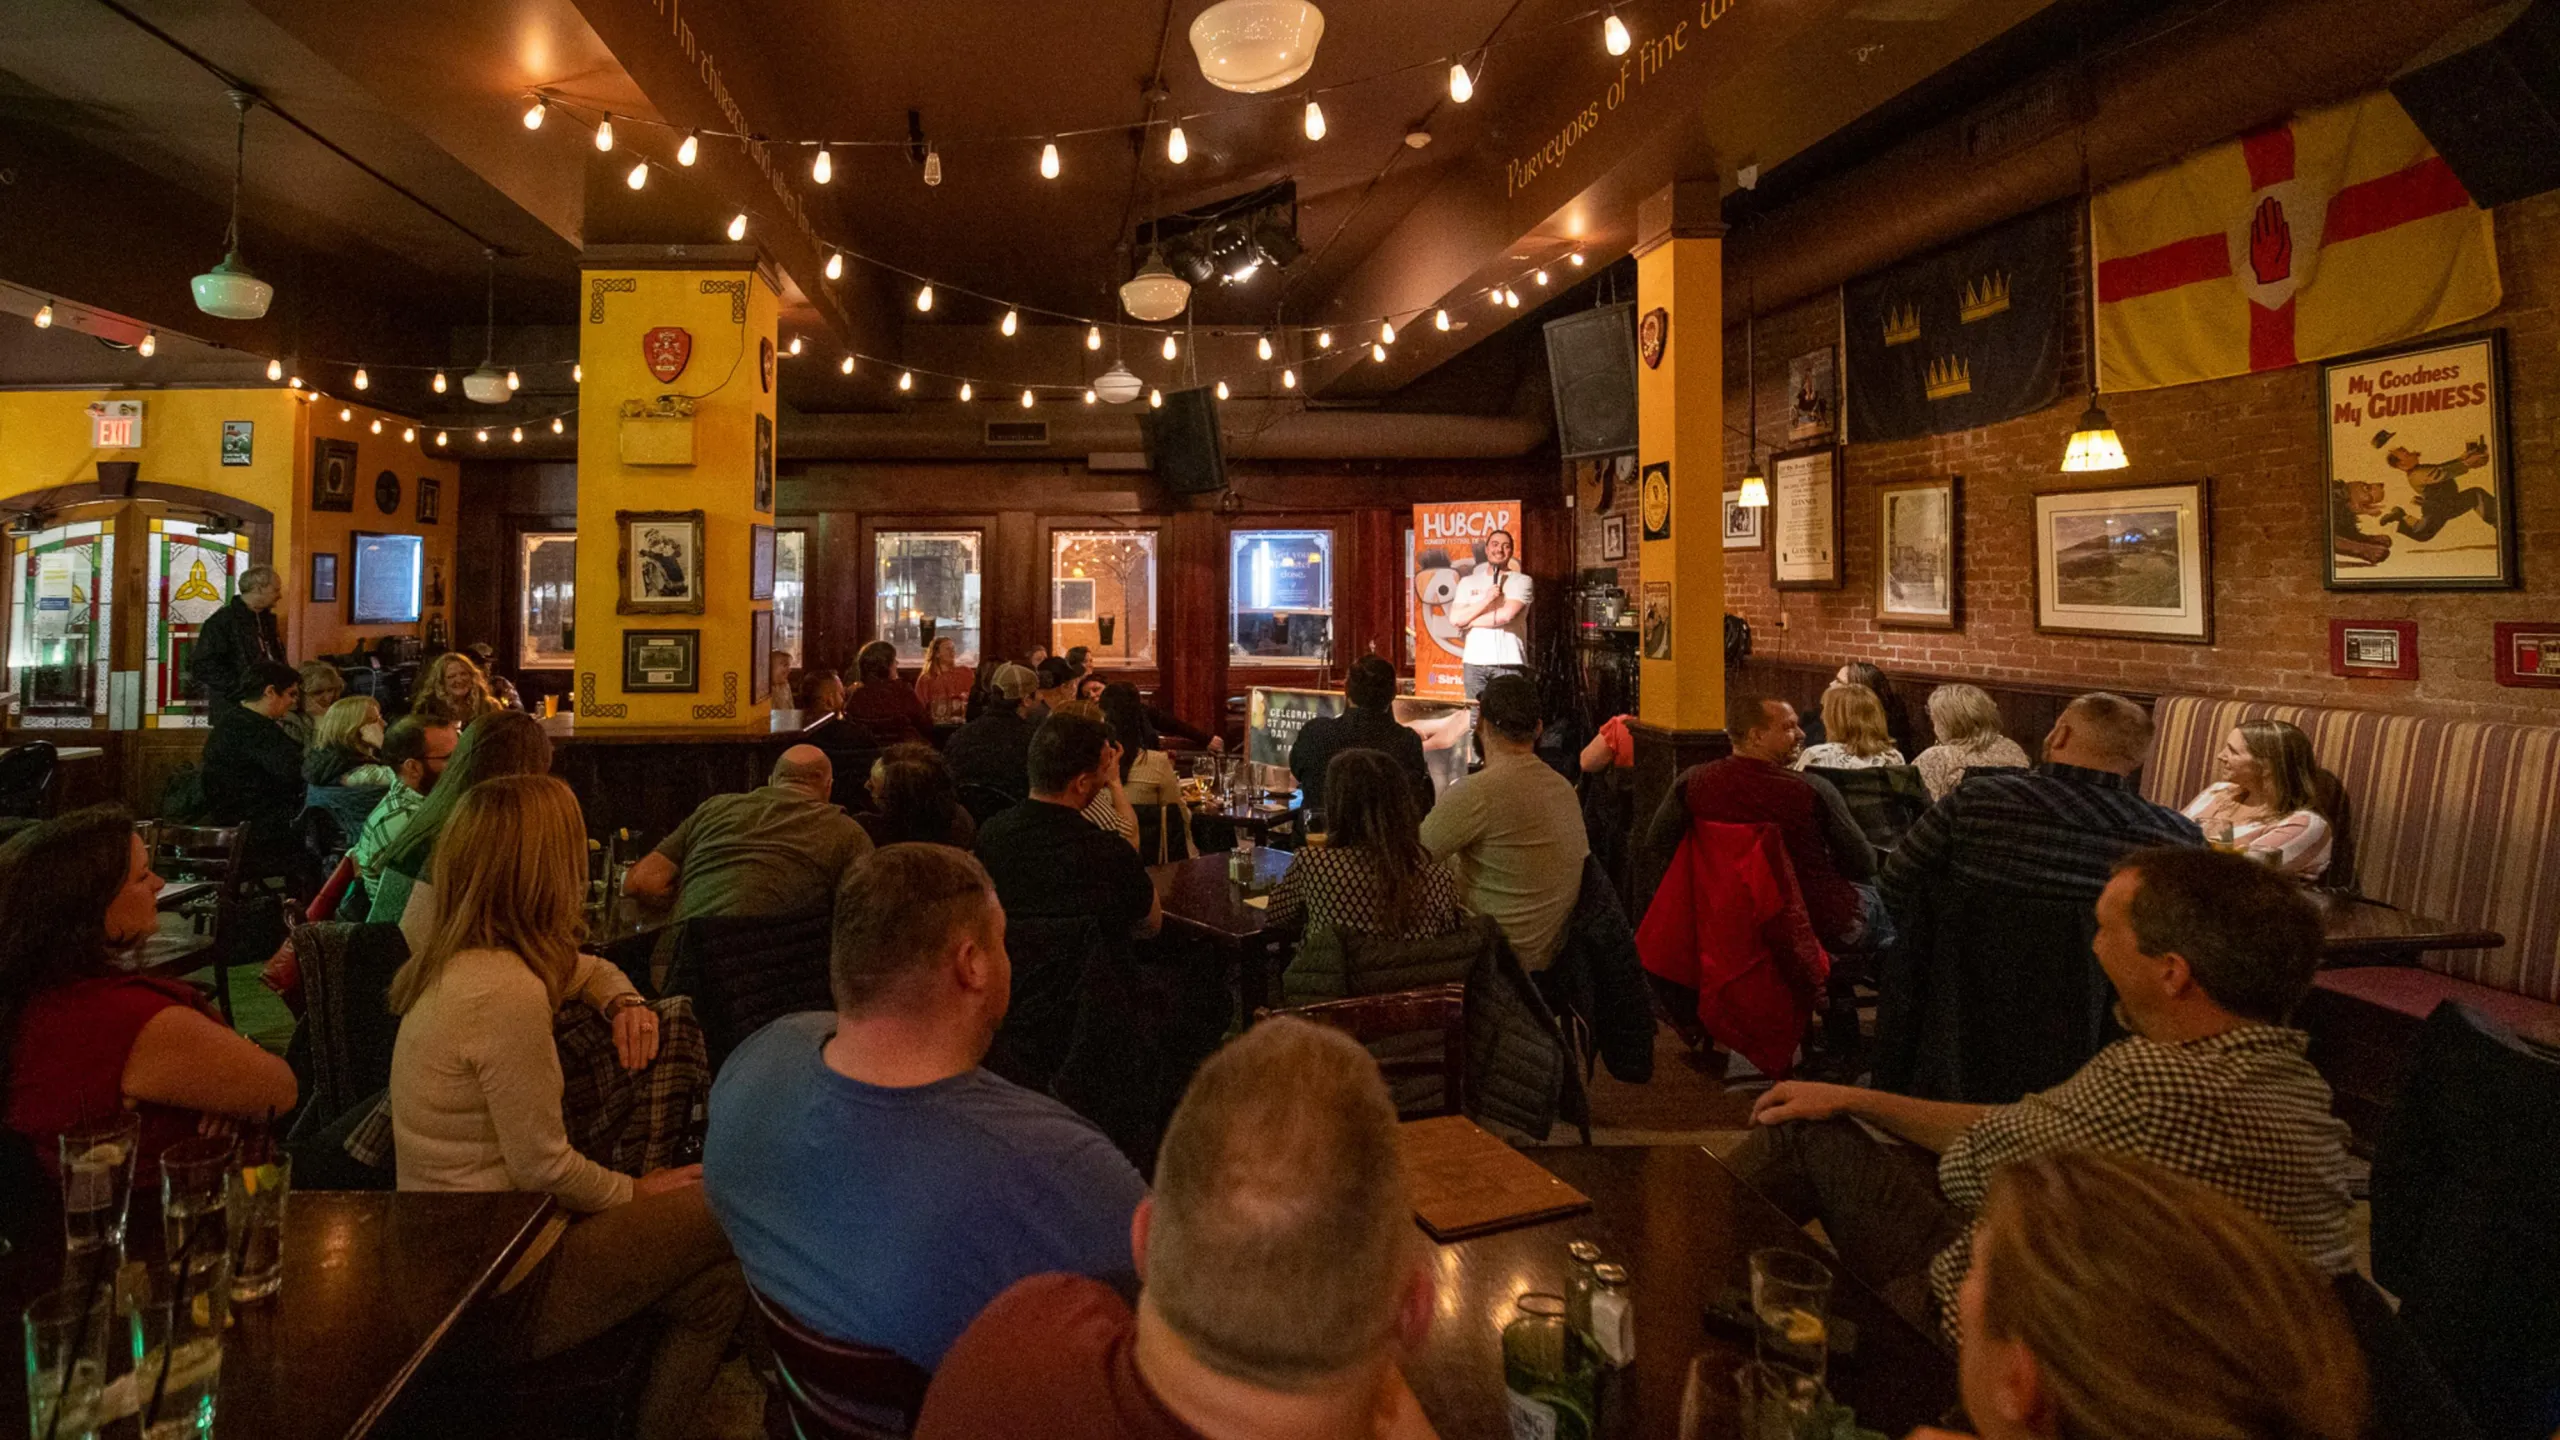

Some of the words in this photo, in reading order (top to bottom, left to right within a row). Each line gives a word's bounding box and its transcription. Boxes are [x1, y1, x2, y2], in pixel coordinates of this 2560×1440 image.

[1506, 101, 1599, 198] Purveyors
[1607, 59, 1630, 110] of
[1640, 20, 1688, 84] fine
[2348, 375, 2373, 396] My
[2379, 365, 2460, 390] Goodness
[2334, 402, 2361, 427] My
[2368, 382, 2486, 420] GUINNESS
[99, 419, 132, 446] EXIT
[1424, 510, 1509, 538] HUBCAP
[1267, 718, 1278, 728] ST
[1270, 708, 1317, 720] CELEBRATE
[1271, 729, 1287, 739] DAY
